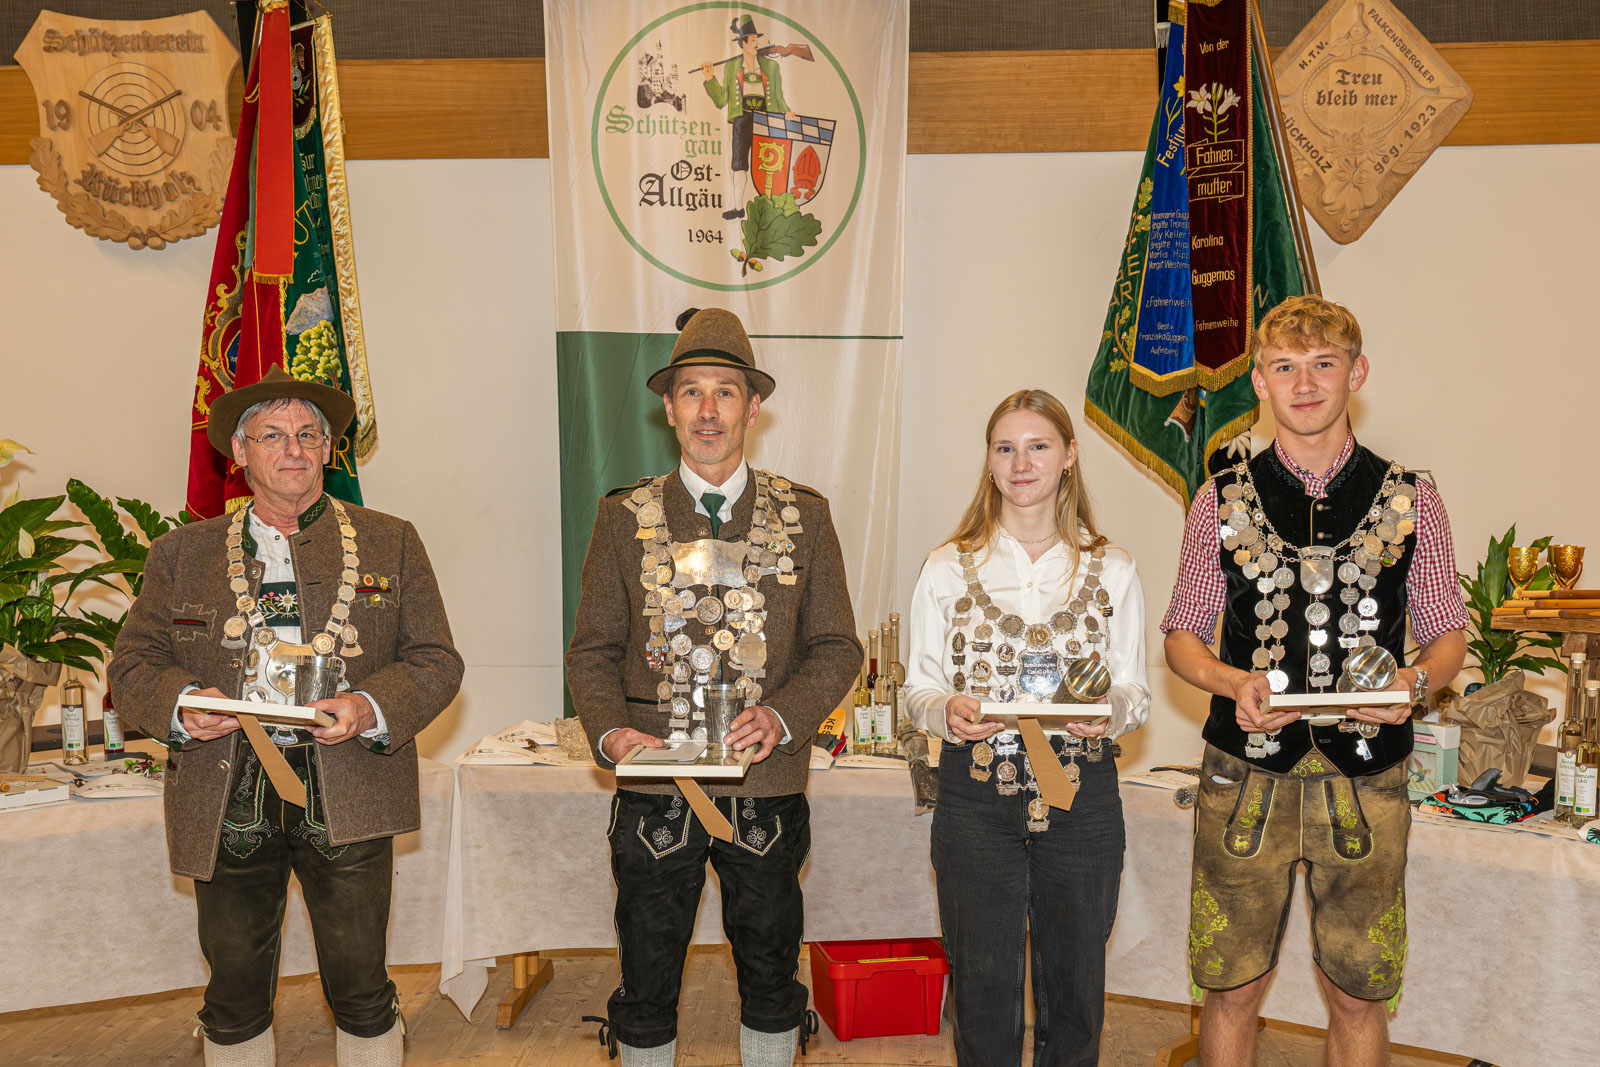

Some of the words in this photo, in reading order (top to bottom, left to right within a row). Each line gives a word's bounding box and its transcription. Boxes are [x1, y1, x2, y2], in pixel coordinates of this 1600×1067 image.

[1199, 42, 1214, 54] Von
[1216, 39, 1230, 51] der
[1298, 40, 1329, 70] H.T.V.
[1367, 8, 1435, 84] FALKENSBERGLER
[1335, 68, 1383, 86] Treu
[1316, 89, 1358, 107] bleib
[1364, 92, 1398, 107] mer
[42, 99, 72, 131] 19
[190, 99, 222, 131] 04
[605, 104, 721, 138] Schützen-
[684, 138, 723, 158] gau
[1373, 142, 1403, 175] geg.
[1403, 104, 1437, 140] 1923
[1196, 146, 1238, 166] Fahnen-
[670, 159, 721, 182] Ost-
[638, 172, 723, 212] Allgäu
[1197, 178, 1233, 196] mutter
[687, 228, 724, 244] 1964
[1191, 234, 1224, 250] Karolina
[1191, 269, 1236, 287] Guggemos
